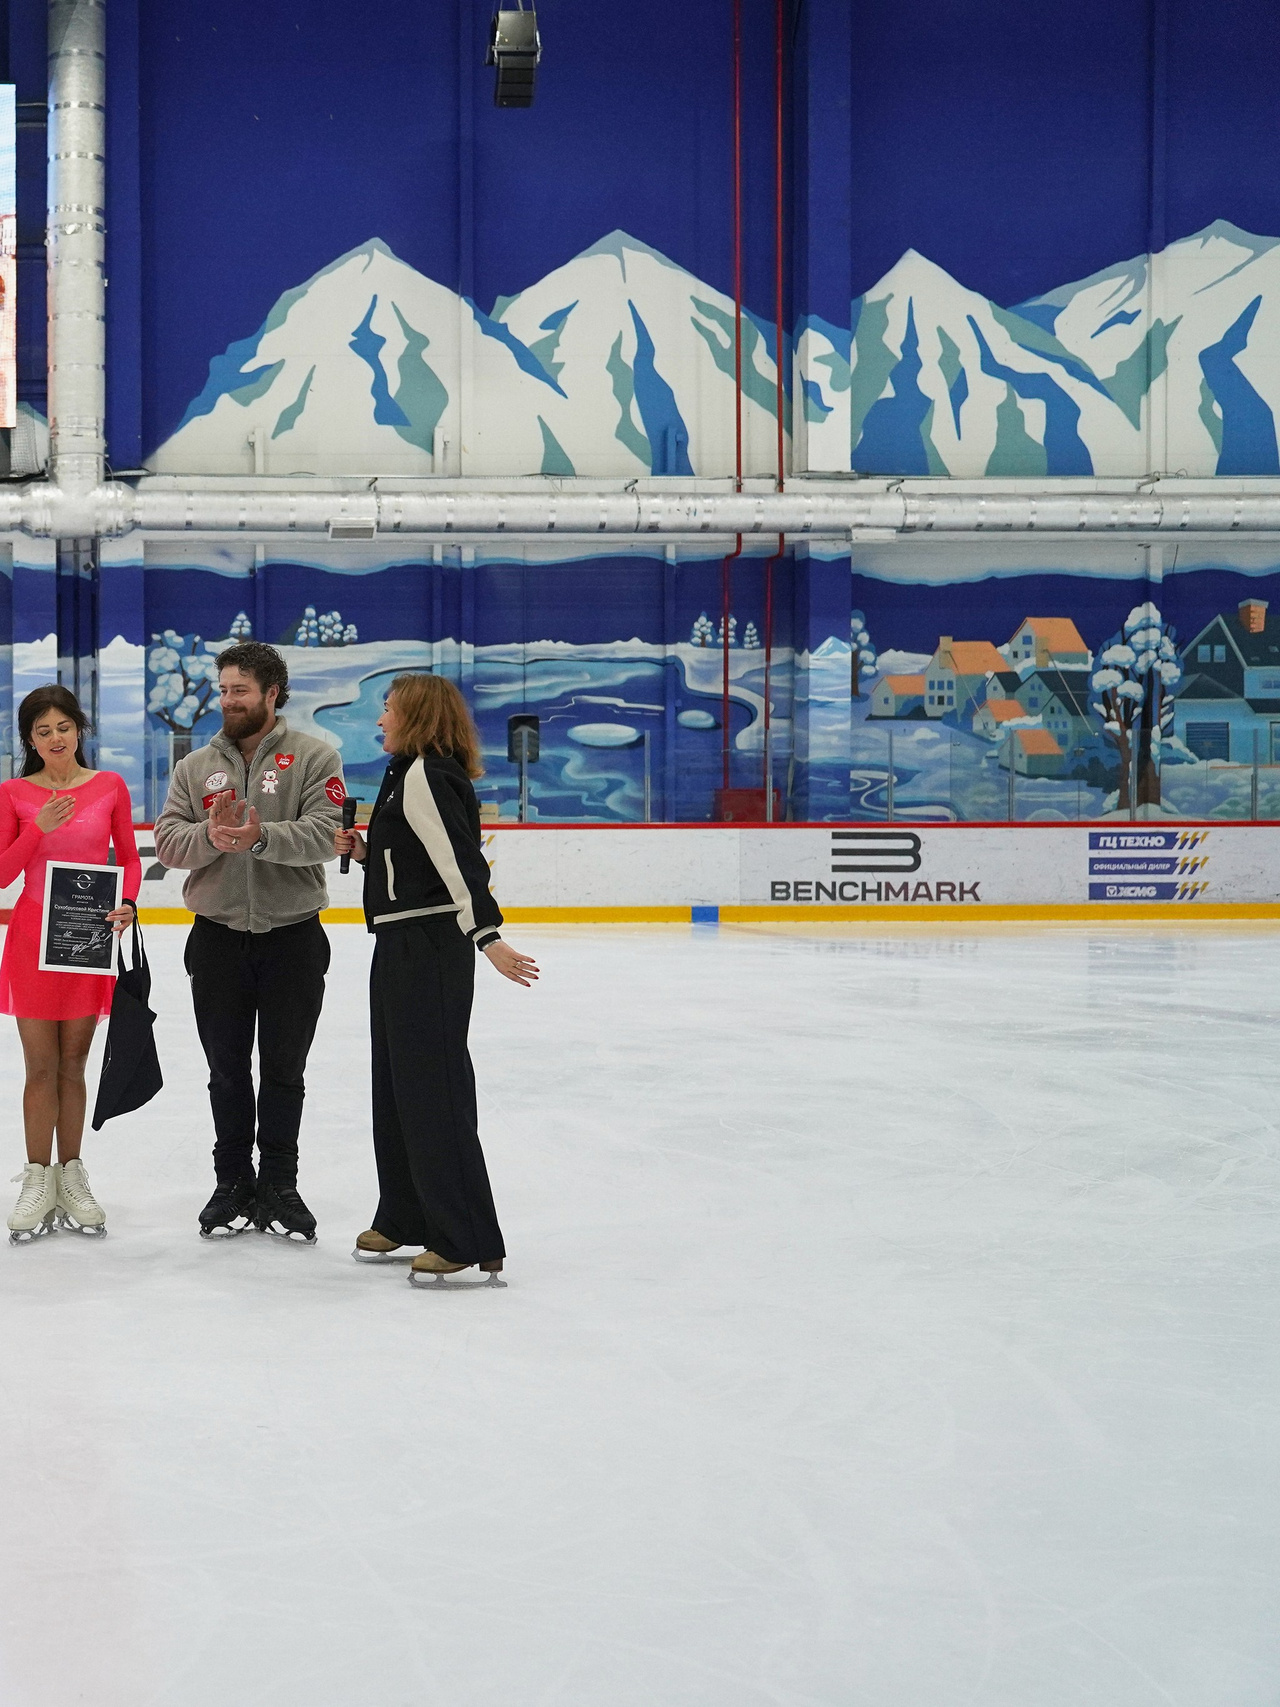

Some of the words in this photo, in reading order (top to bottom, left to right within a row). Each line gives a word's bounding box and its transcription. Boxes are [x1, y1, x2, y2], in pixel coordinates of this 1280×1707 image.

[1099, 836, 1117, 848] ГЦ
[1119, 836, 1166, 847] ТЕХНО
[1093, 862, 1147, 871] ОФИЦИАЛЬНЫЙ
[1148, 863, 1171, 871] ДИЛЕР
[770, 880, 982, 903] BENCHMARK
[1118, 886, 1157, 897] XCMG
